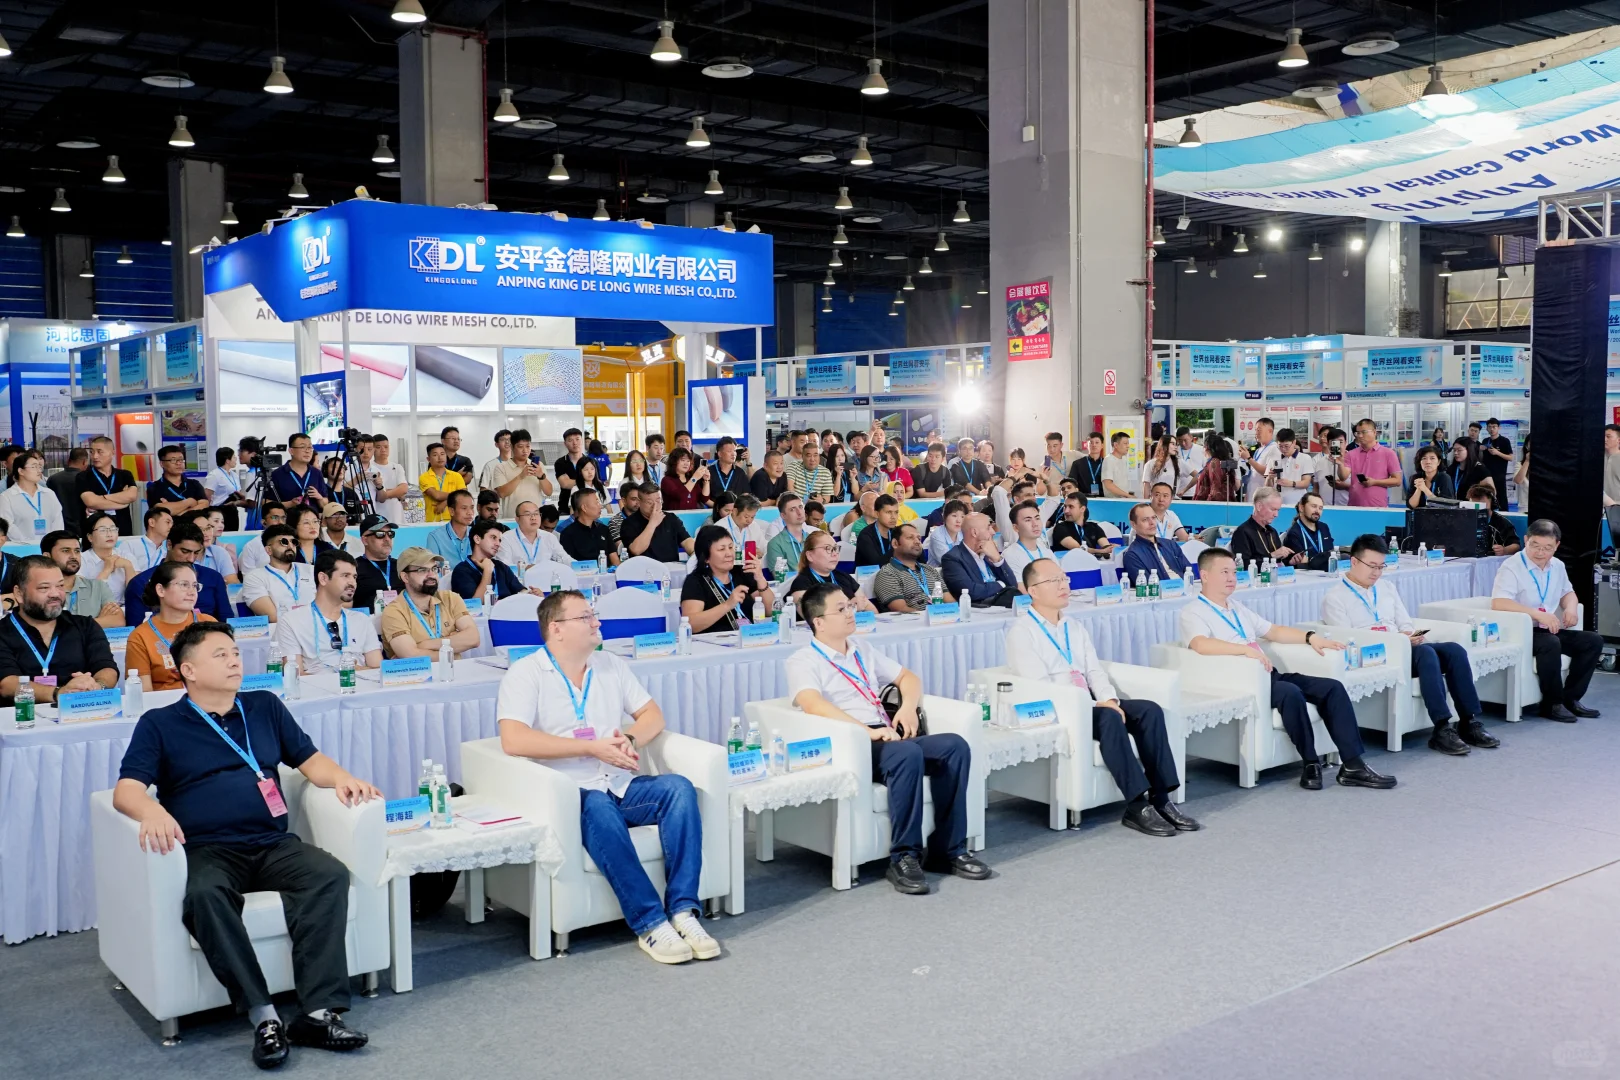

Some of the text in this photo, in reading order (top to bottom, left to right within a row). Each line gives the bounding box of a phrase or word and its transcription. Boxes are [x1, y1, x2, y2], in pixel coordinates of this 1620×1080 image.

[1503, 123, 1620, 163] World
[1384, 159, 1504, 192] Capital
[1272, 189, 1349, 200] Wire
[1347, 185, 1382, 198] of
[1371, 173, 1557, 212] Anping
[495, 243, 737, 284] 安平金德隆网业有限公司
[496, 275, 738, 299] ANPING KING DE LONG WIRE MESH CO.,LTD.
[355, 311, 372, 323] DE
[376, 312, 413, 325] LONG
[416, 314, 449, 327] WIRE
[452, 315, 487, 328] MESH
[490, 316, 537, 330] CO.,LTD.
[46, 327, 110, 342] 河北思固
[1193, 354, 1231, 364] 世界丝网看安平
[1266, 362, 1305, 370] 界丝网看安平
[1371, 356, 1422, 366] 世界丝网看安平
[71, 701, 95, 709] BARDIUG
